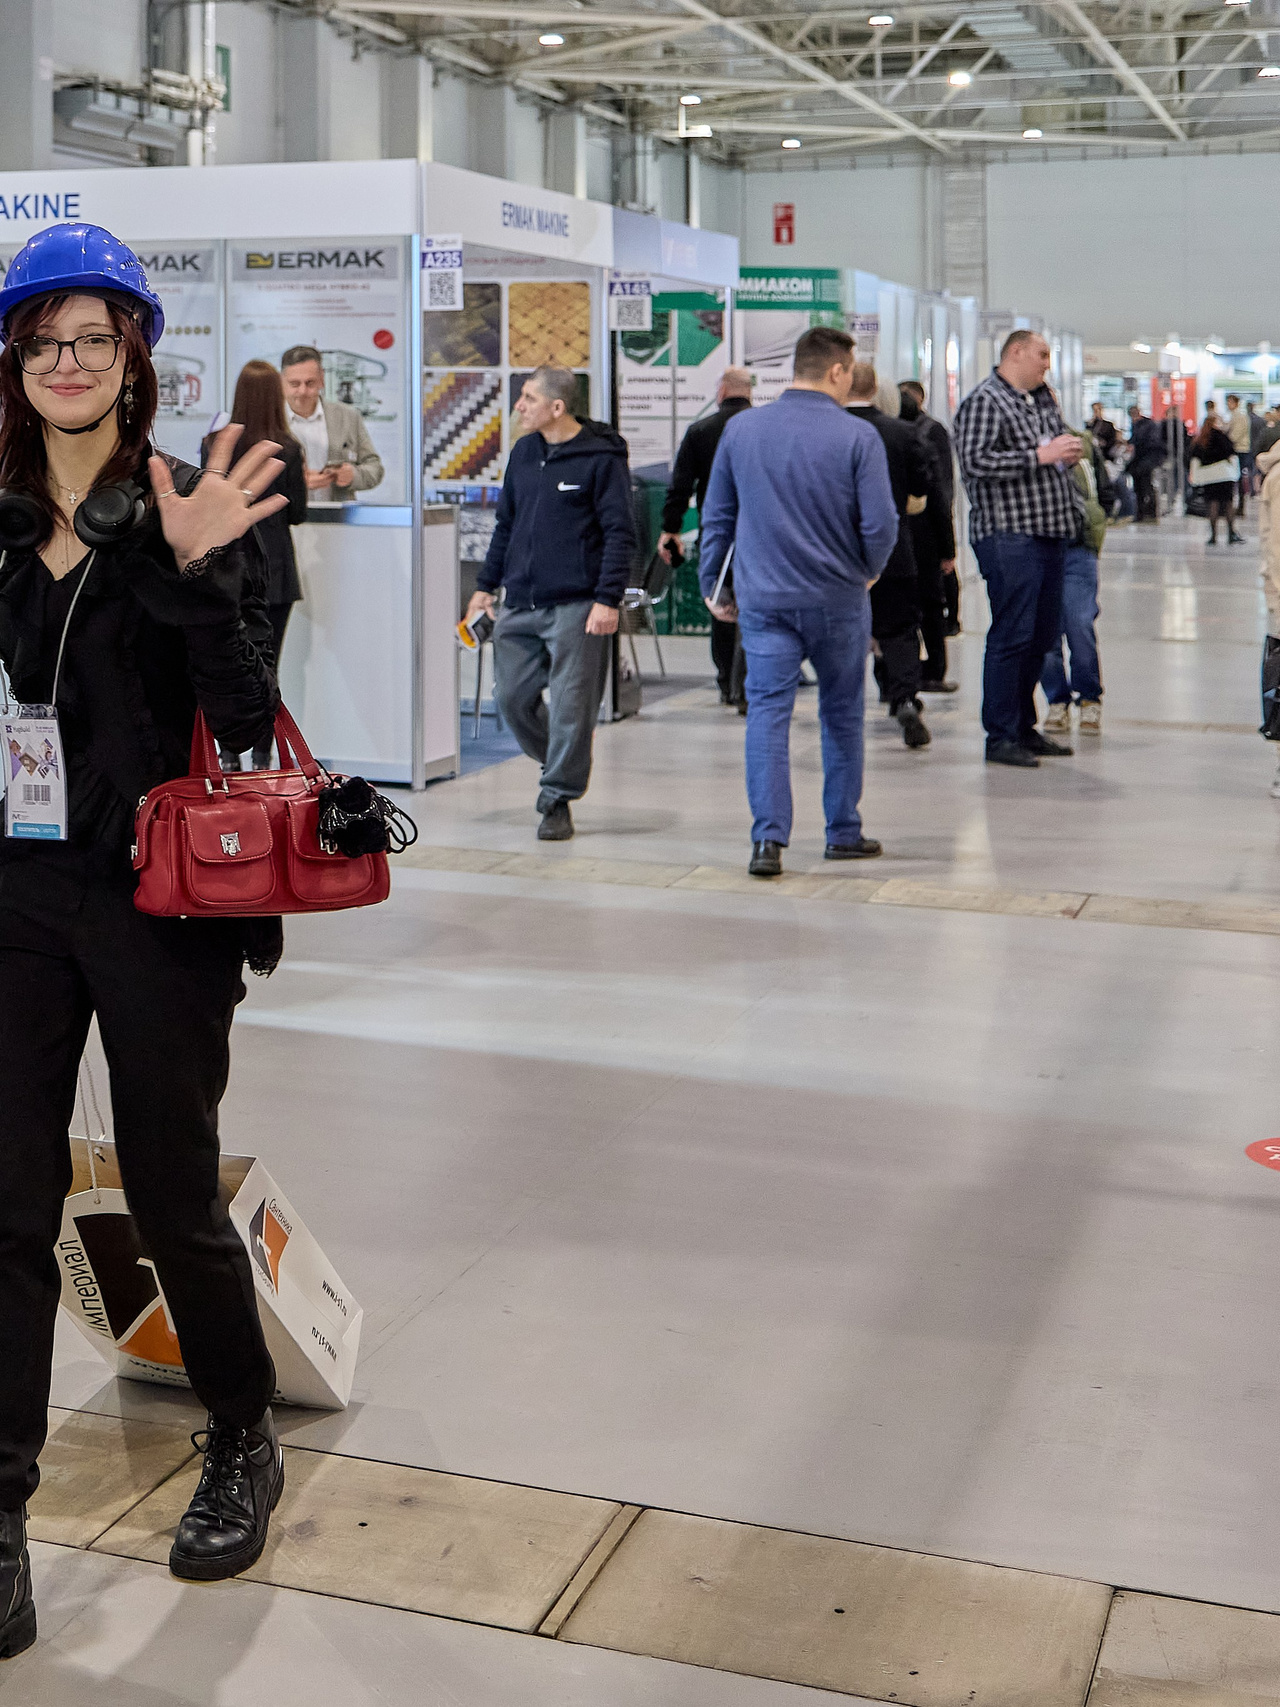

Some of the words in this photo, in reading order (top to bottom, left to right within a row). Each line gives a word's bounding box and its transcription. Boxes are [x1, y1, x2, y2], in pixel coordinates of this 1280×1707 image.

[501, 202, 534, 231] ERMAK
[535, 209, 569, 238] MAKINE
[278, 249, 385, 270] ERMAK
[424, 251, 460, 268] A235
